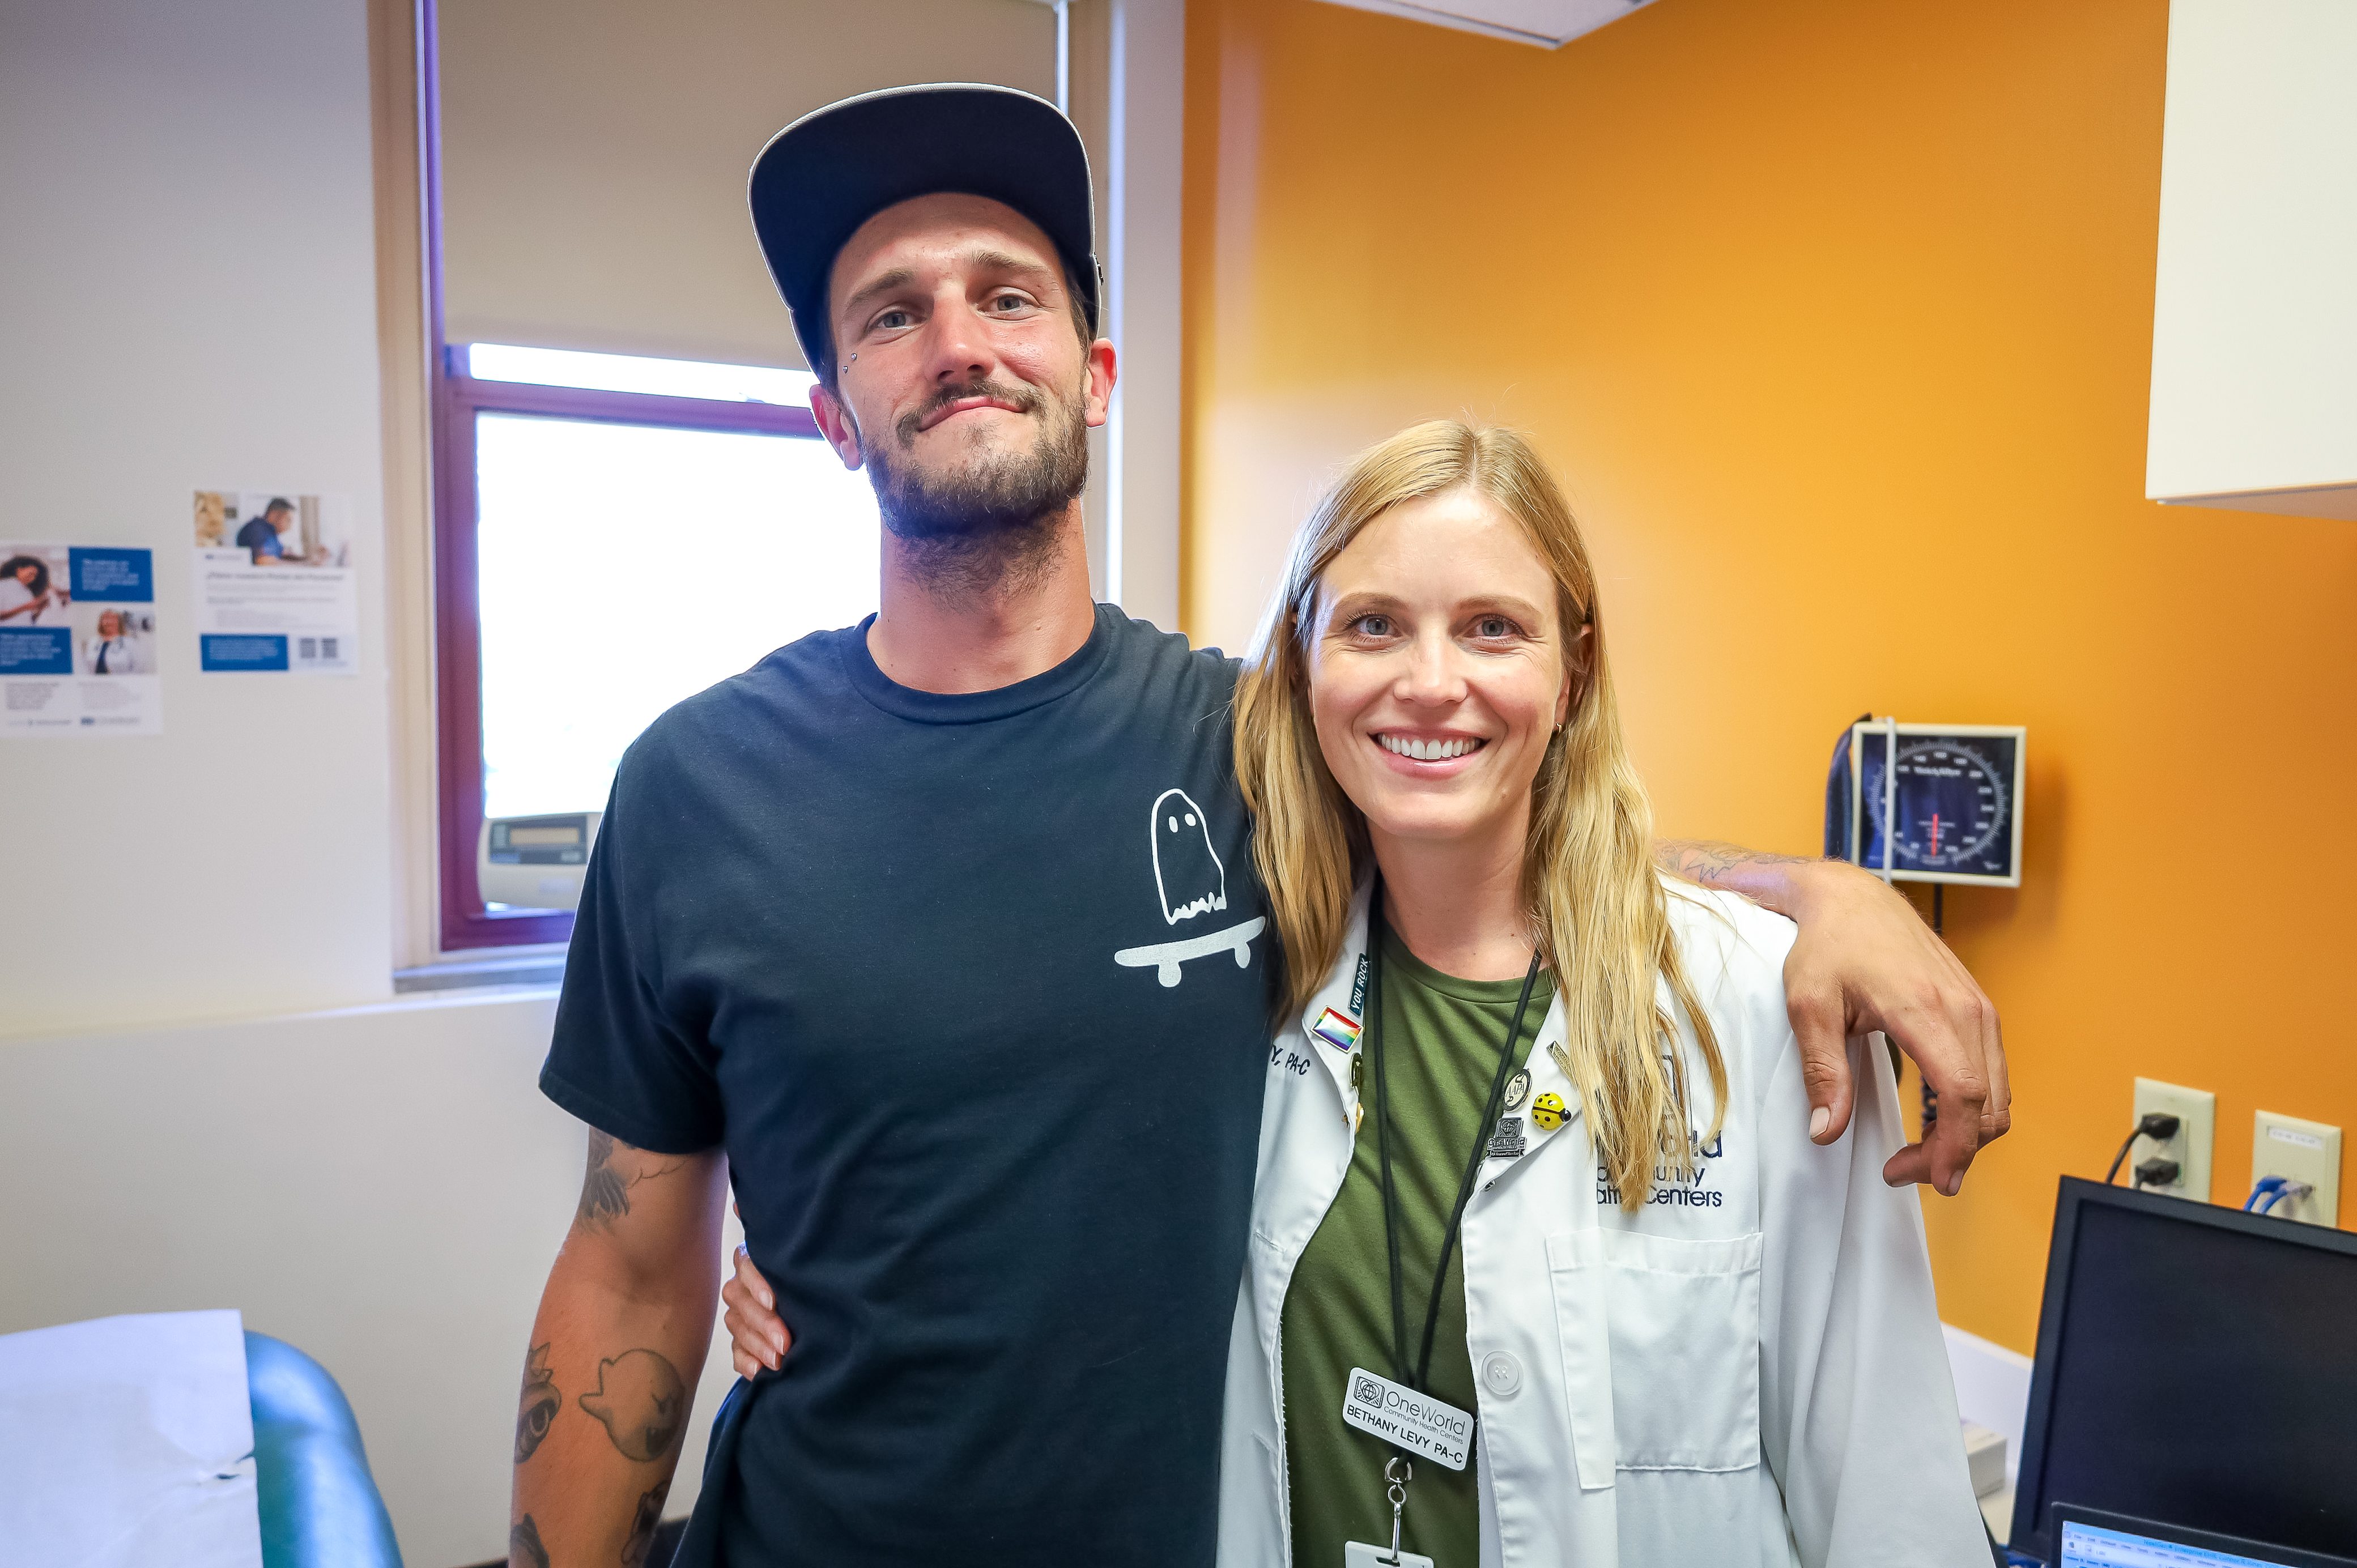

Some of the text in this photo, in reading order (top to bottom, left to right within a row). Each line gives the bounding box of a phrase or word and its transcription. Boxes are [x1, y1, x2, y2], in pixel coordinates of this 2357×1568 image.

[1352, 957, 1368, 1009] YOU ROCK
[1285, 1052, 1311, 1075] PA-C
[1505, 1083, 1525, 1097] AAPA
[1347, 1404, 1463, 1464] BETHANY LEVY PA-C
[1384, 1406, 1463, 1445] Community Health Centers
[1386, 1391, 1465, 1436] OneWorld
